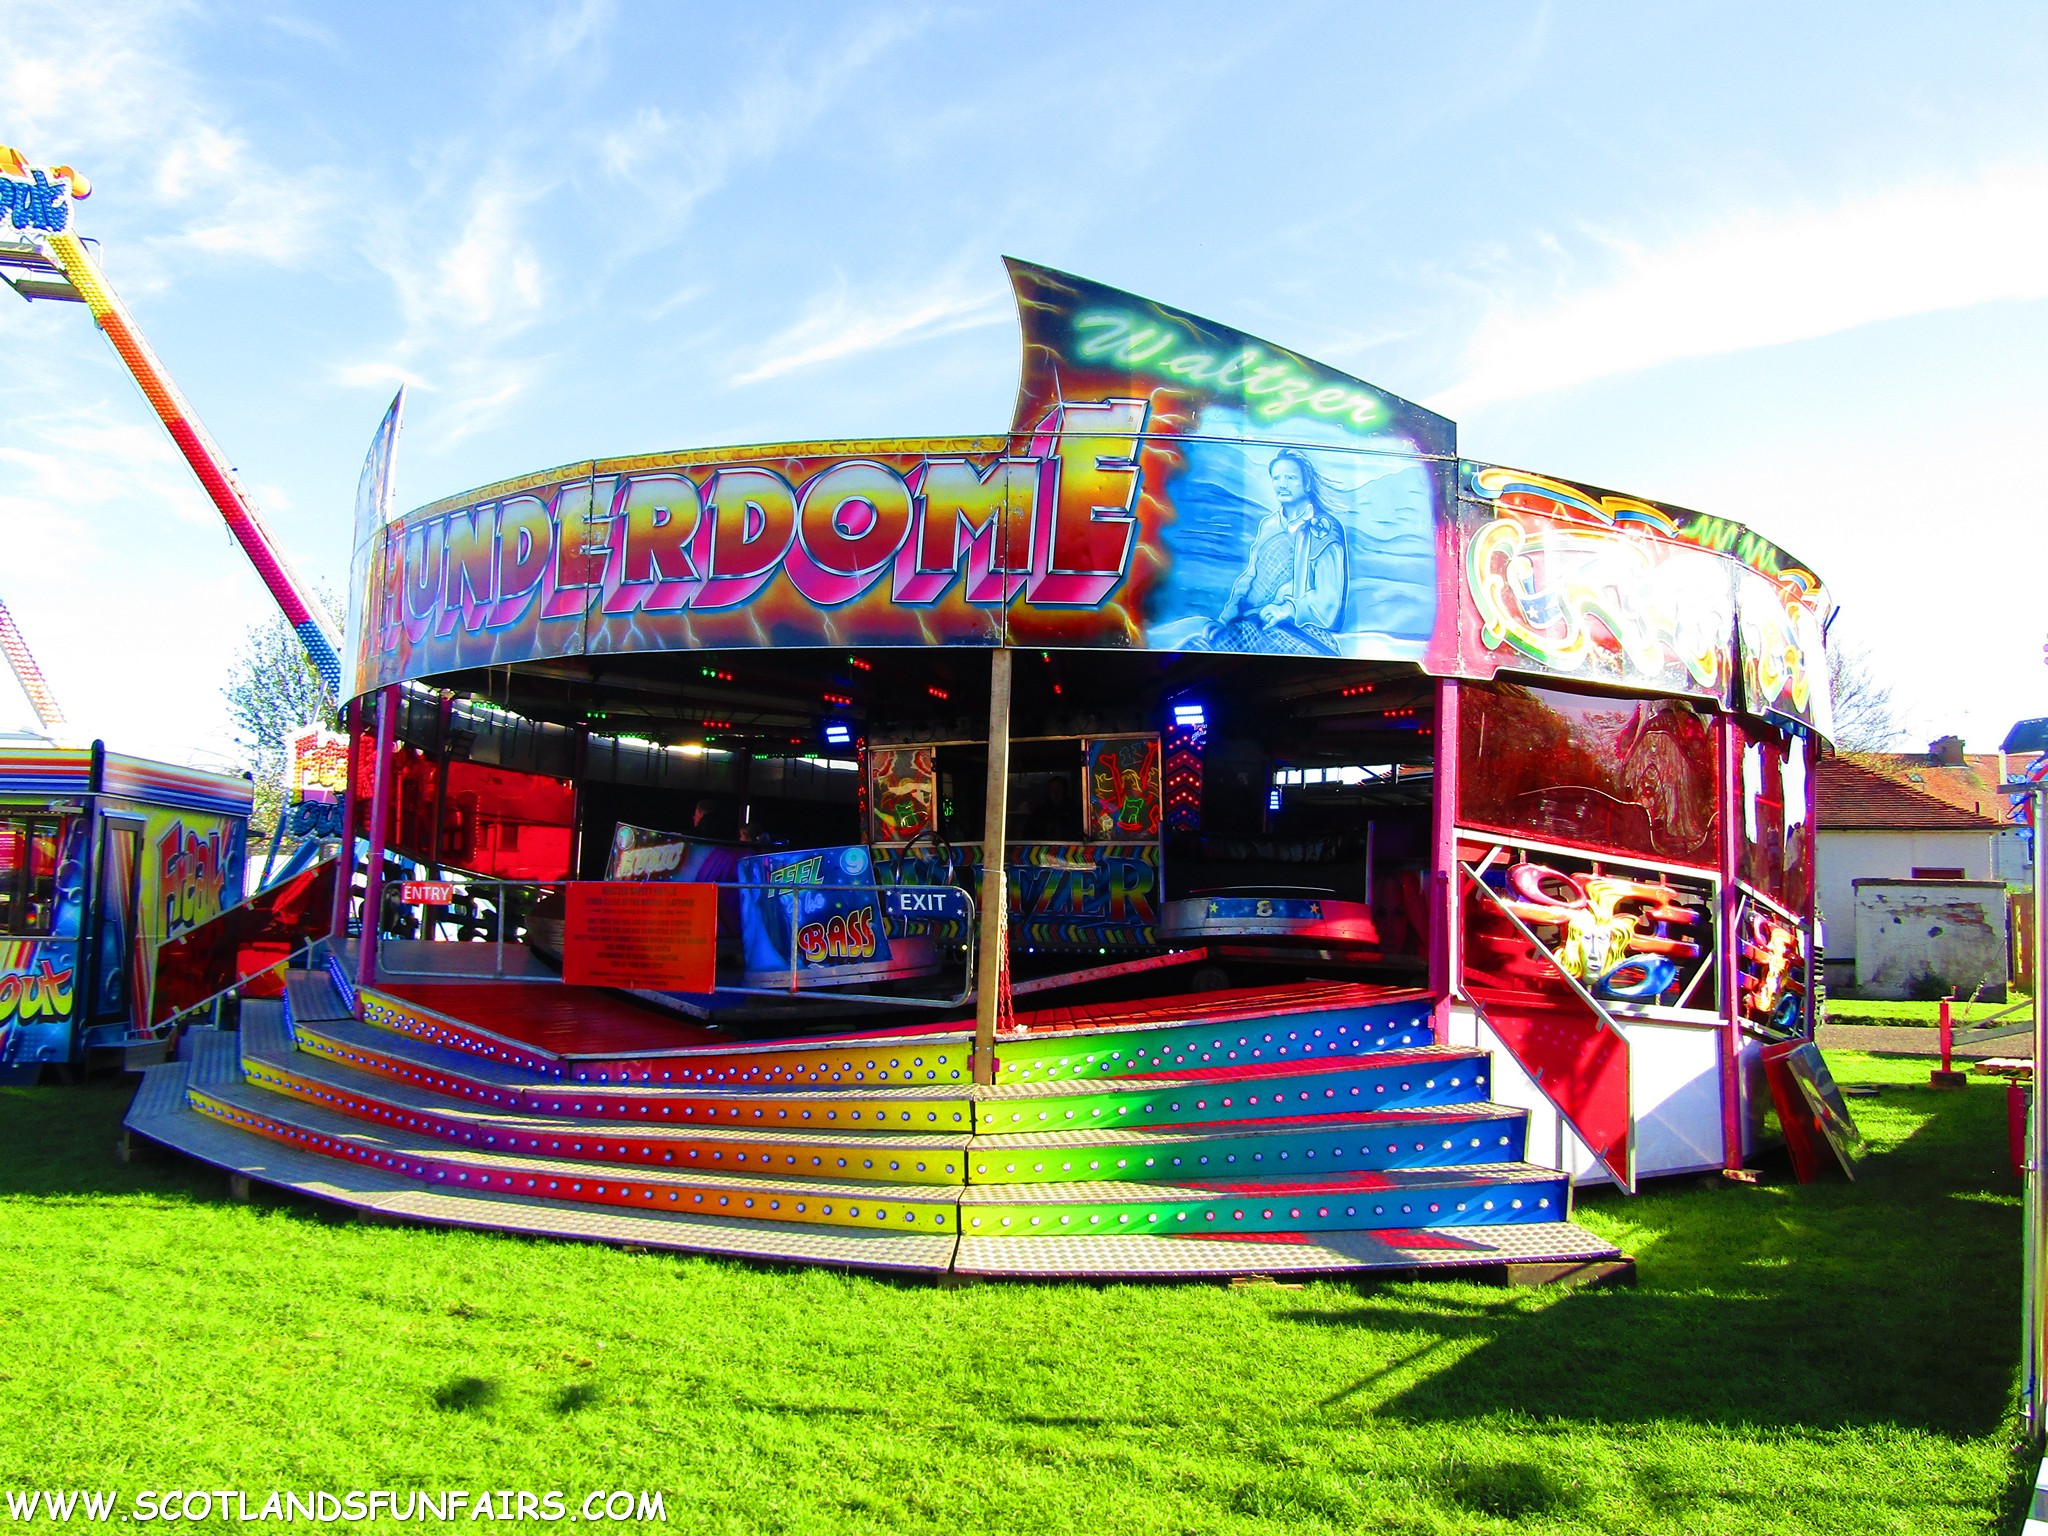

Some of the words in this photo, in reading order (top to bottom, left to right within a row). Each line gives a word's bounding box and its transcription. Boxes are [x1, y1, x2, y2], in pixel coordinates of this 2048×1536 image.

[1077, 312, 1381, 425] Waltzer
[158, 820, 224, 942] Freak
[404, 885, 450, 901] ENTRY
[768, 856, 824, 898] FEEL
[845, 853, 864, 876] 9
[900, 893, 946, 912] EXIT
[1256, 900, 1273, 917] 8
[799, 907, 875, 962] BASS
